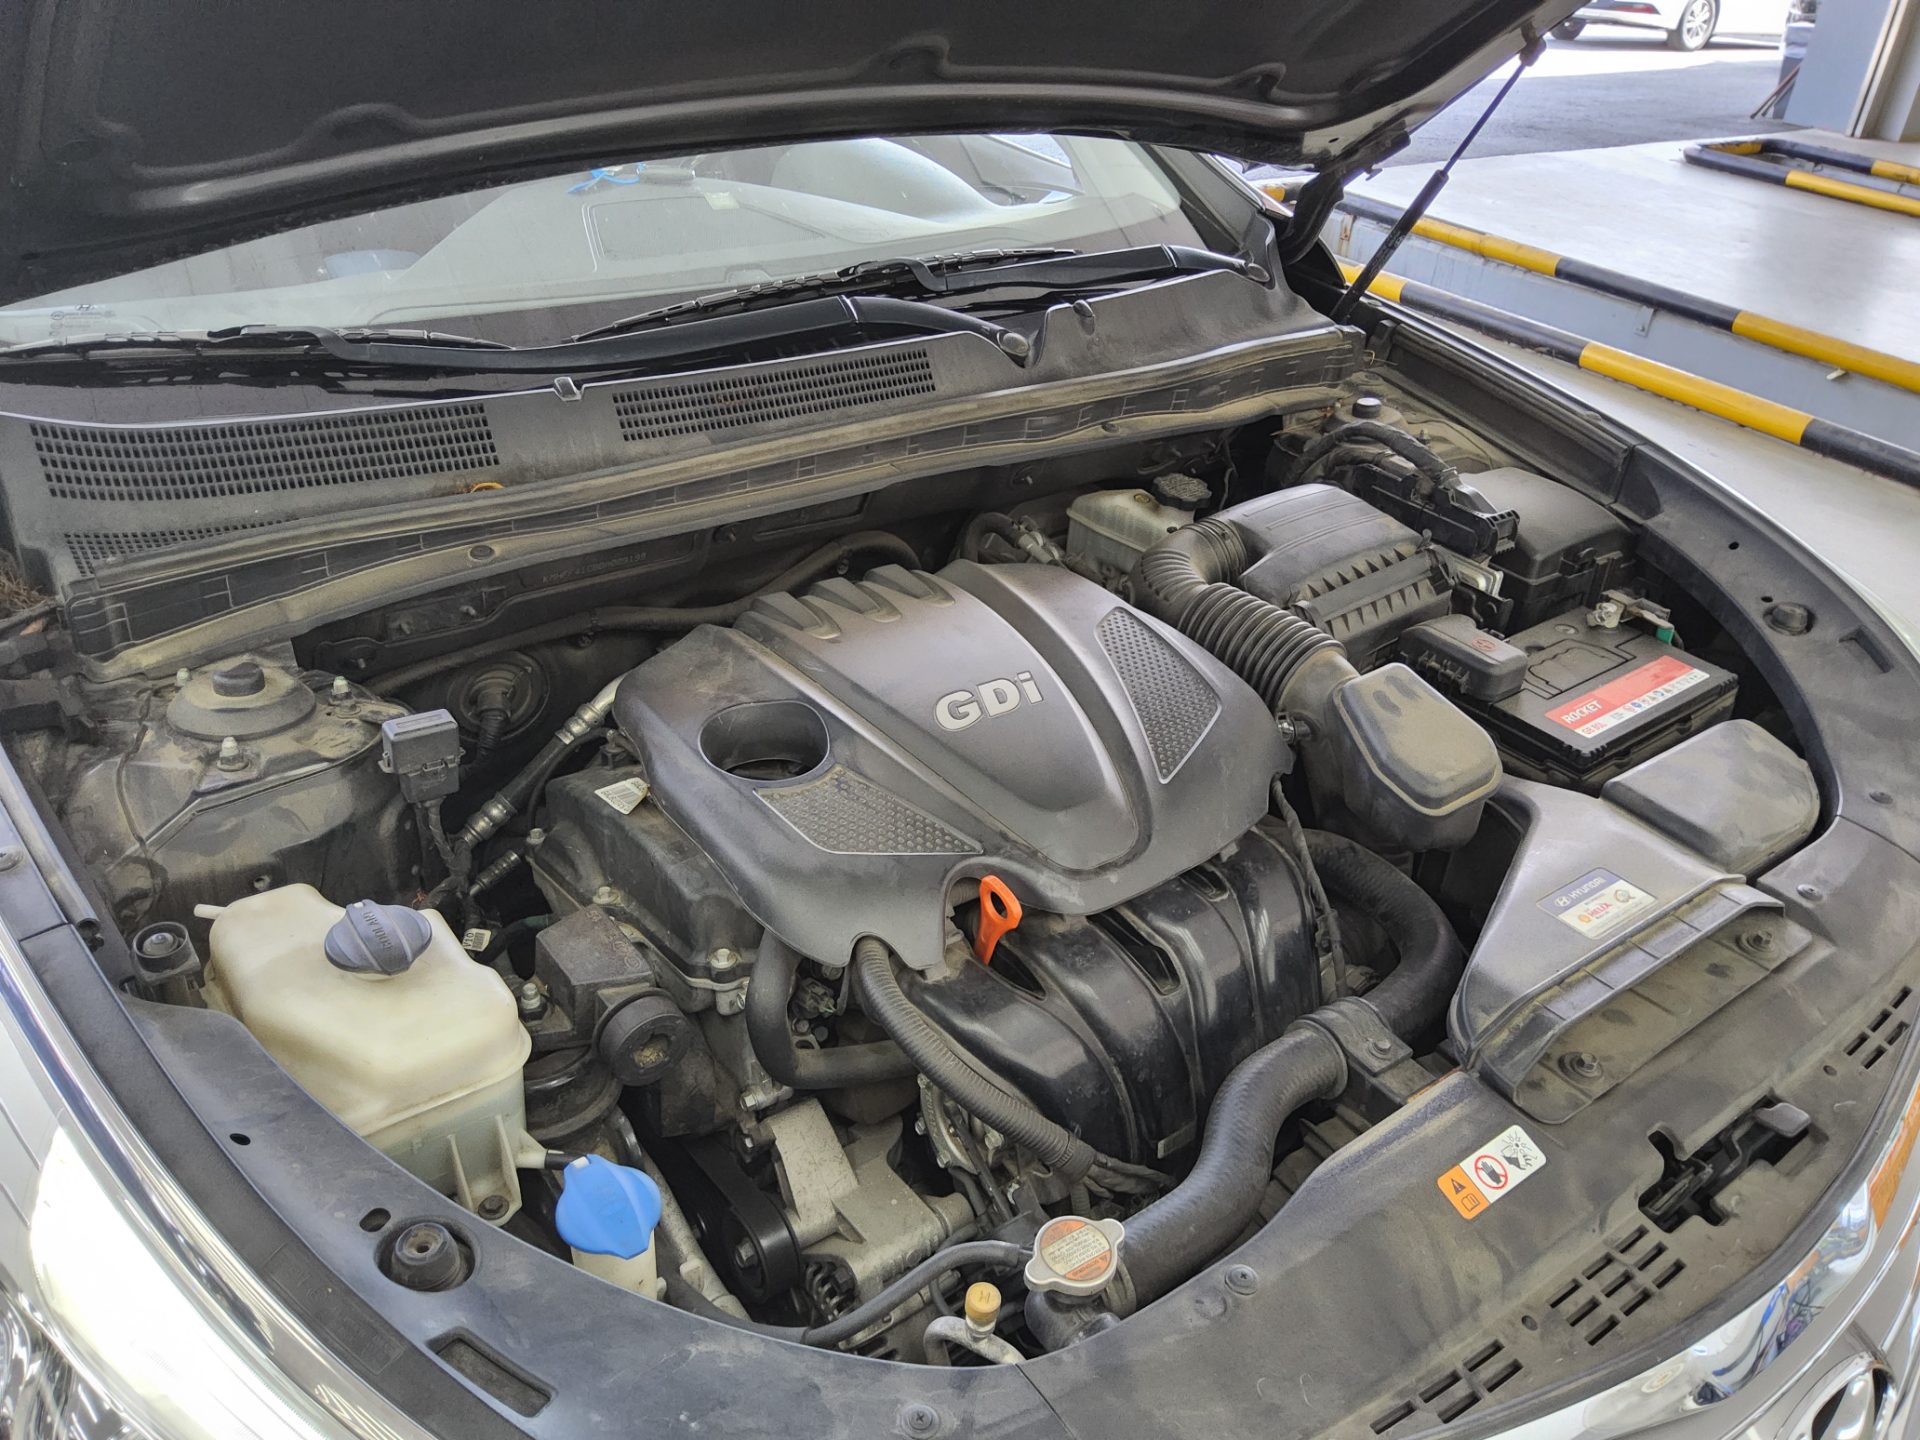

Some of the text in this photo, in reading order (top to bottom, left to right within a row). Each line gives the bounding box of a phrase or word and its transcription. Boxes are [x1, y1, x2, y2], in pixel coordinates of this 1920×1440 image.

[935, 670, 1044, 731] GDi
[1561, 700, 1604, 724] ROCKET
[1568, 877, 1606, 900] HYUNDAI
